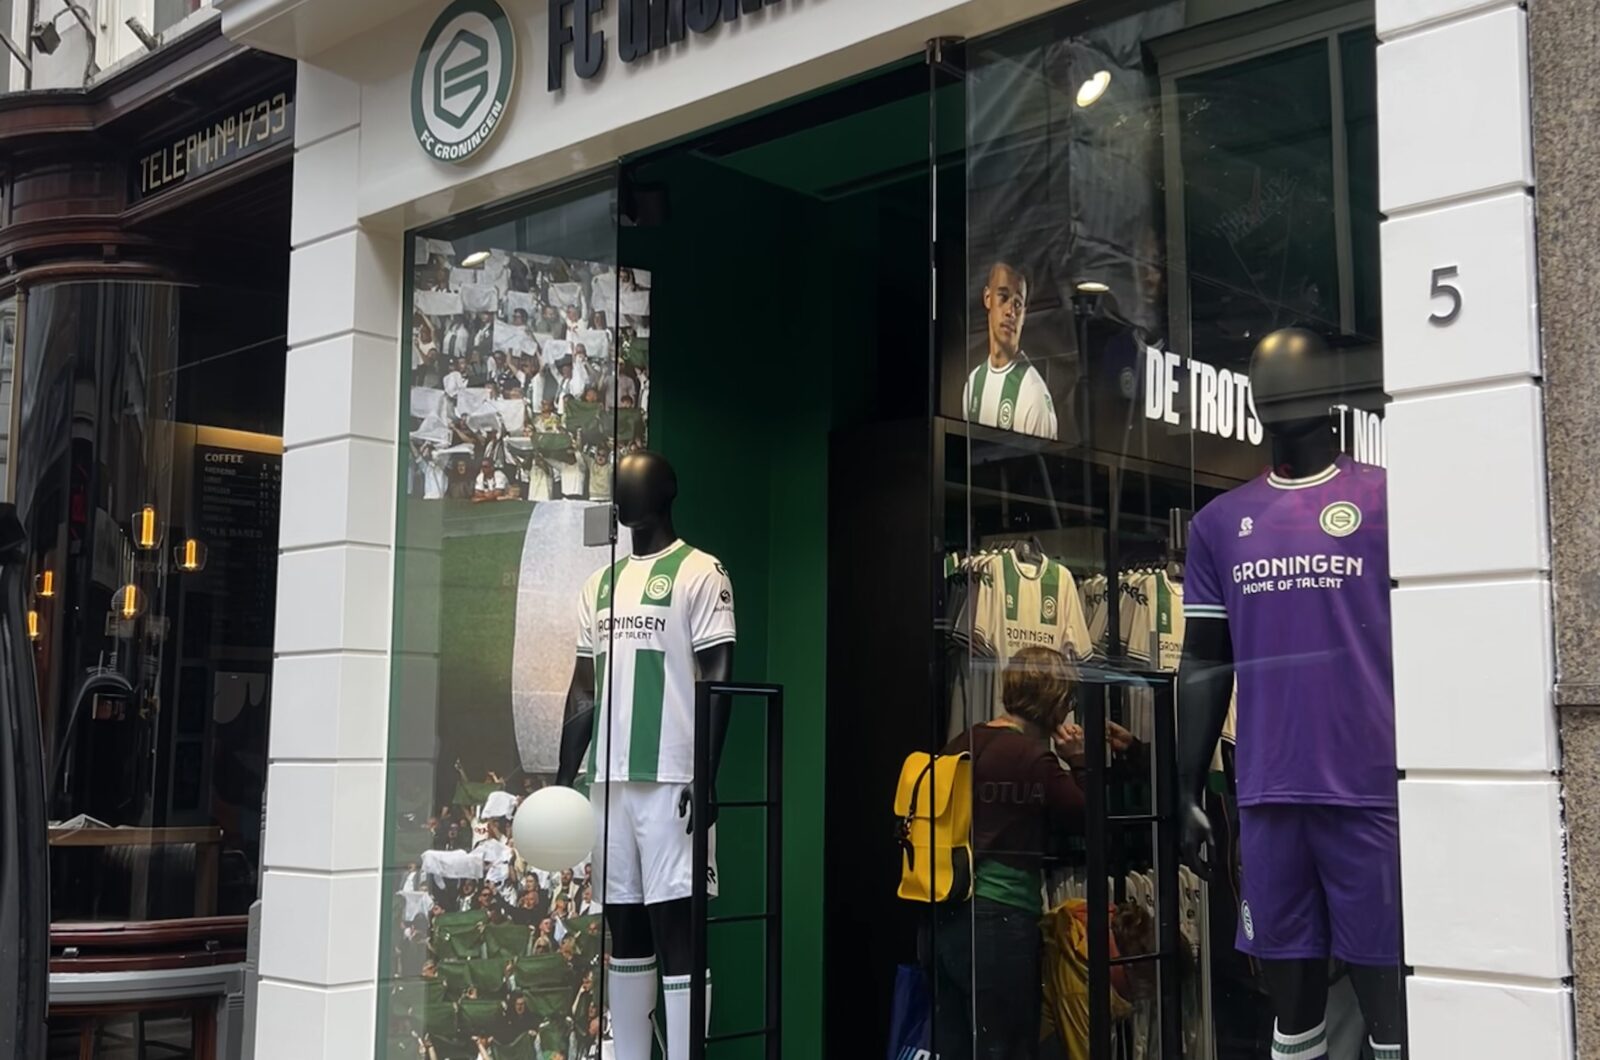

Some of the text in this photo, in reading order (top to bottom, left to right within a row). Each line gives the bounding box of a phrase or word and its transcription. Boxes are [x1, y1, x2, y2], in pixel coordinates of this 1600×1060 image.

[548, 0, 605, 92] FC
[238, 93, 286, 149] 1733
[420, 100, 503, 159] FC GRONINGEN
[1428, 265, 1462, 328] 5
[1145, 346, 1181, 425] DE
[204, 452, 244, 464] COFFEE
[1232, 554, 1363, 584] GRONINGEN
[1243, 577, 1343, 595] HOME OF TALENT
[598, 616, 666, 632] RONINGEN
